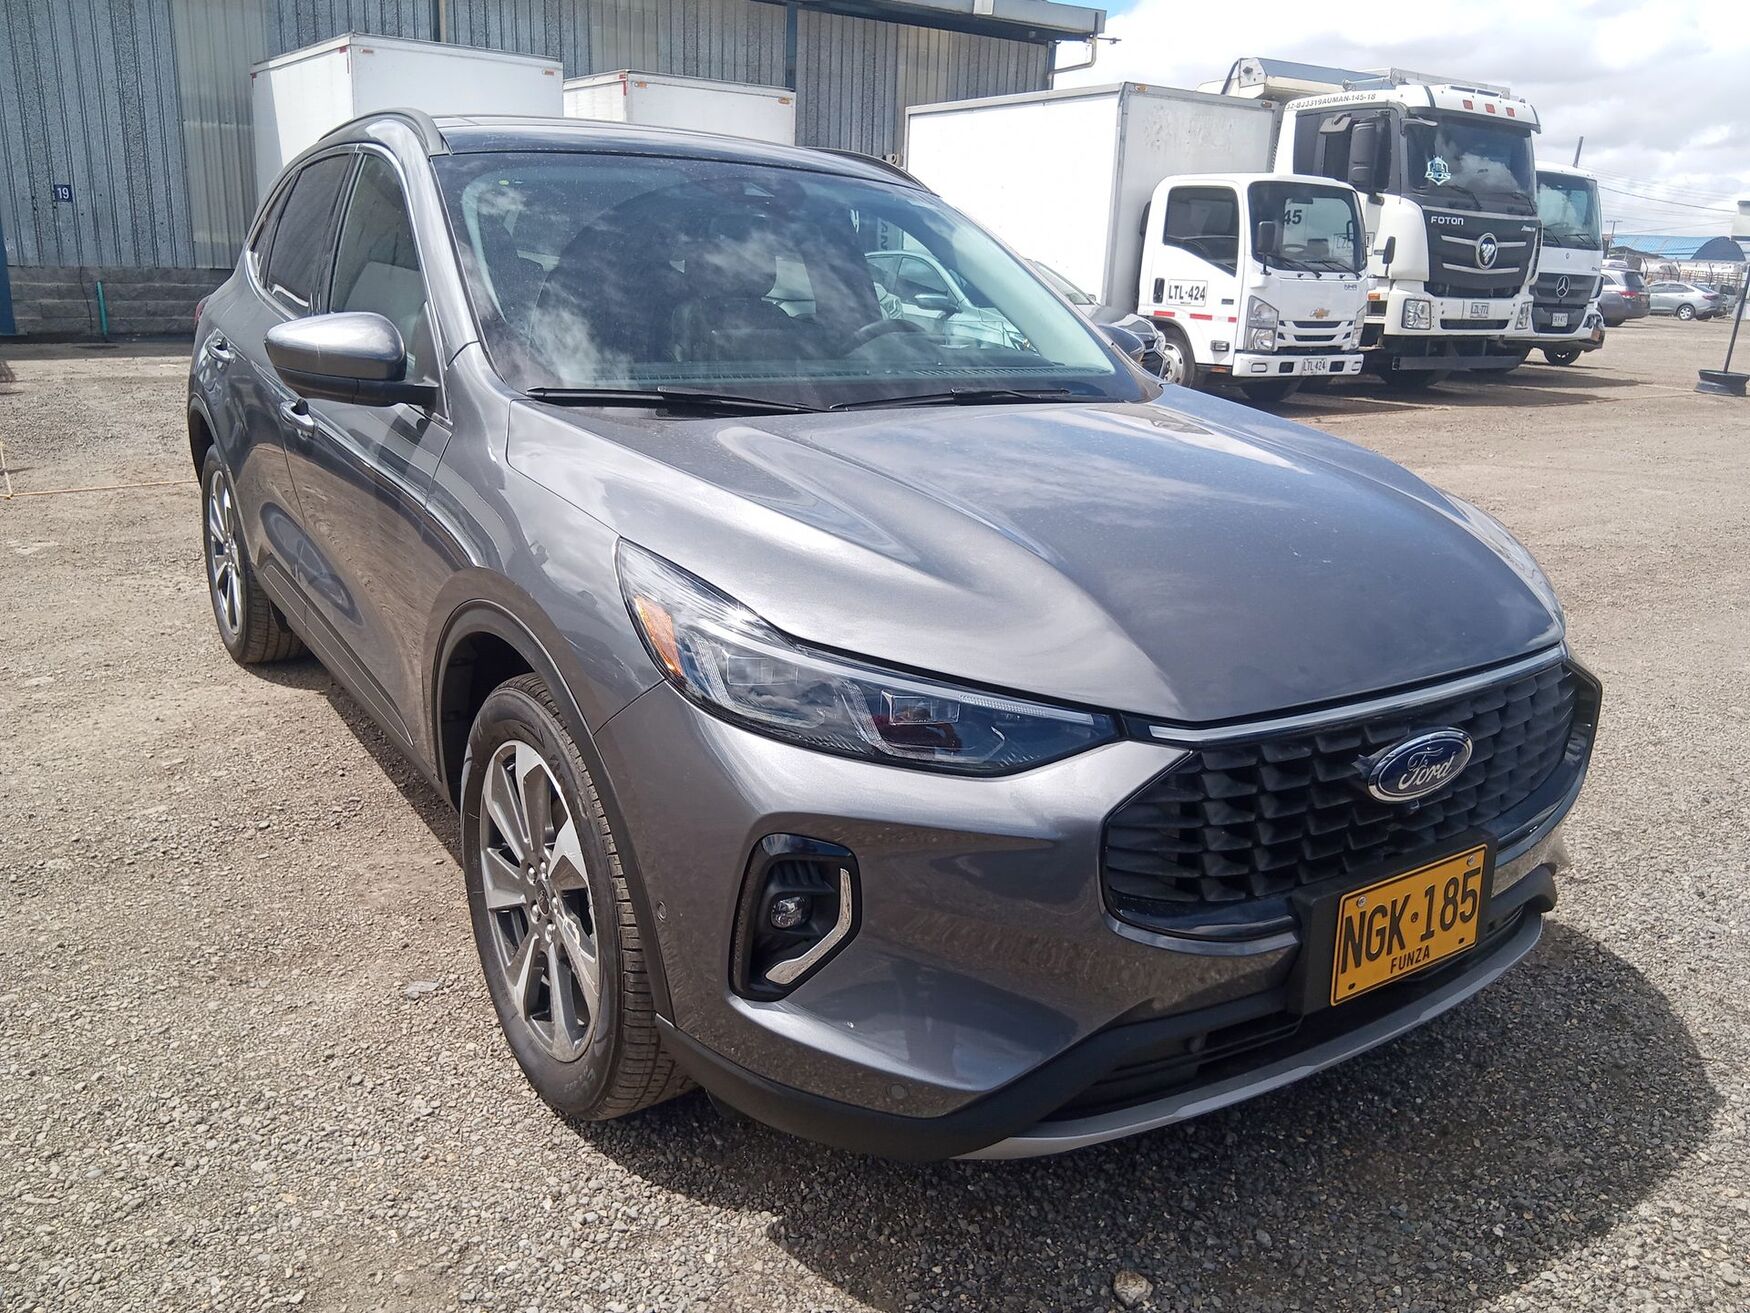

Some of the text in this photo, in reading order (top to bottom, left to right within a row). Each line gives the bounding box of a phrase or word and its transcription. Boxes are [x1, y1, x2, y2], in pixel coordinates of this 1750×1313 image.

[57, 187, 70, 199] 19
[1430, 215, 1464, 226] FOTON
[1397, 747, 1455, 790] Ford
[1390, 944, 1430, 974] FUNZA
